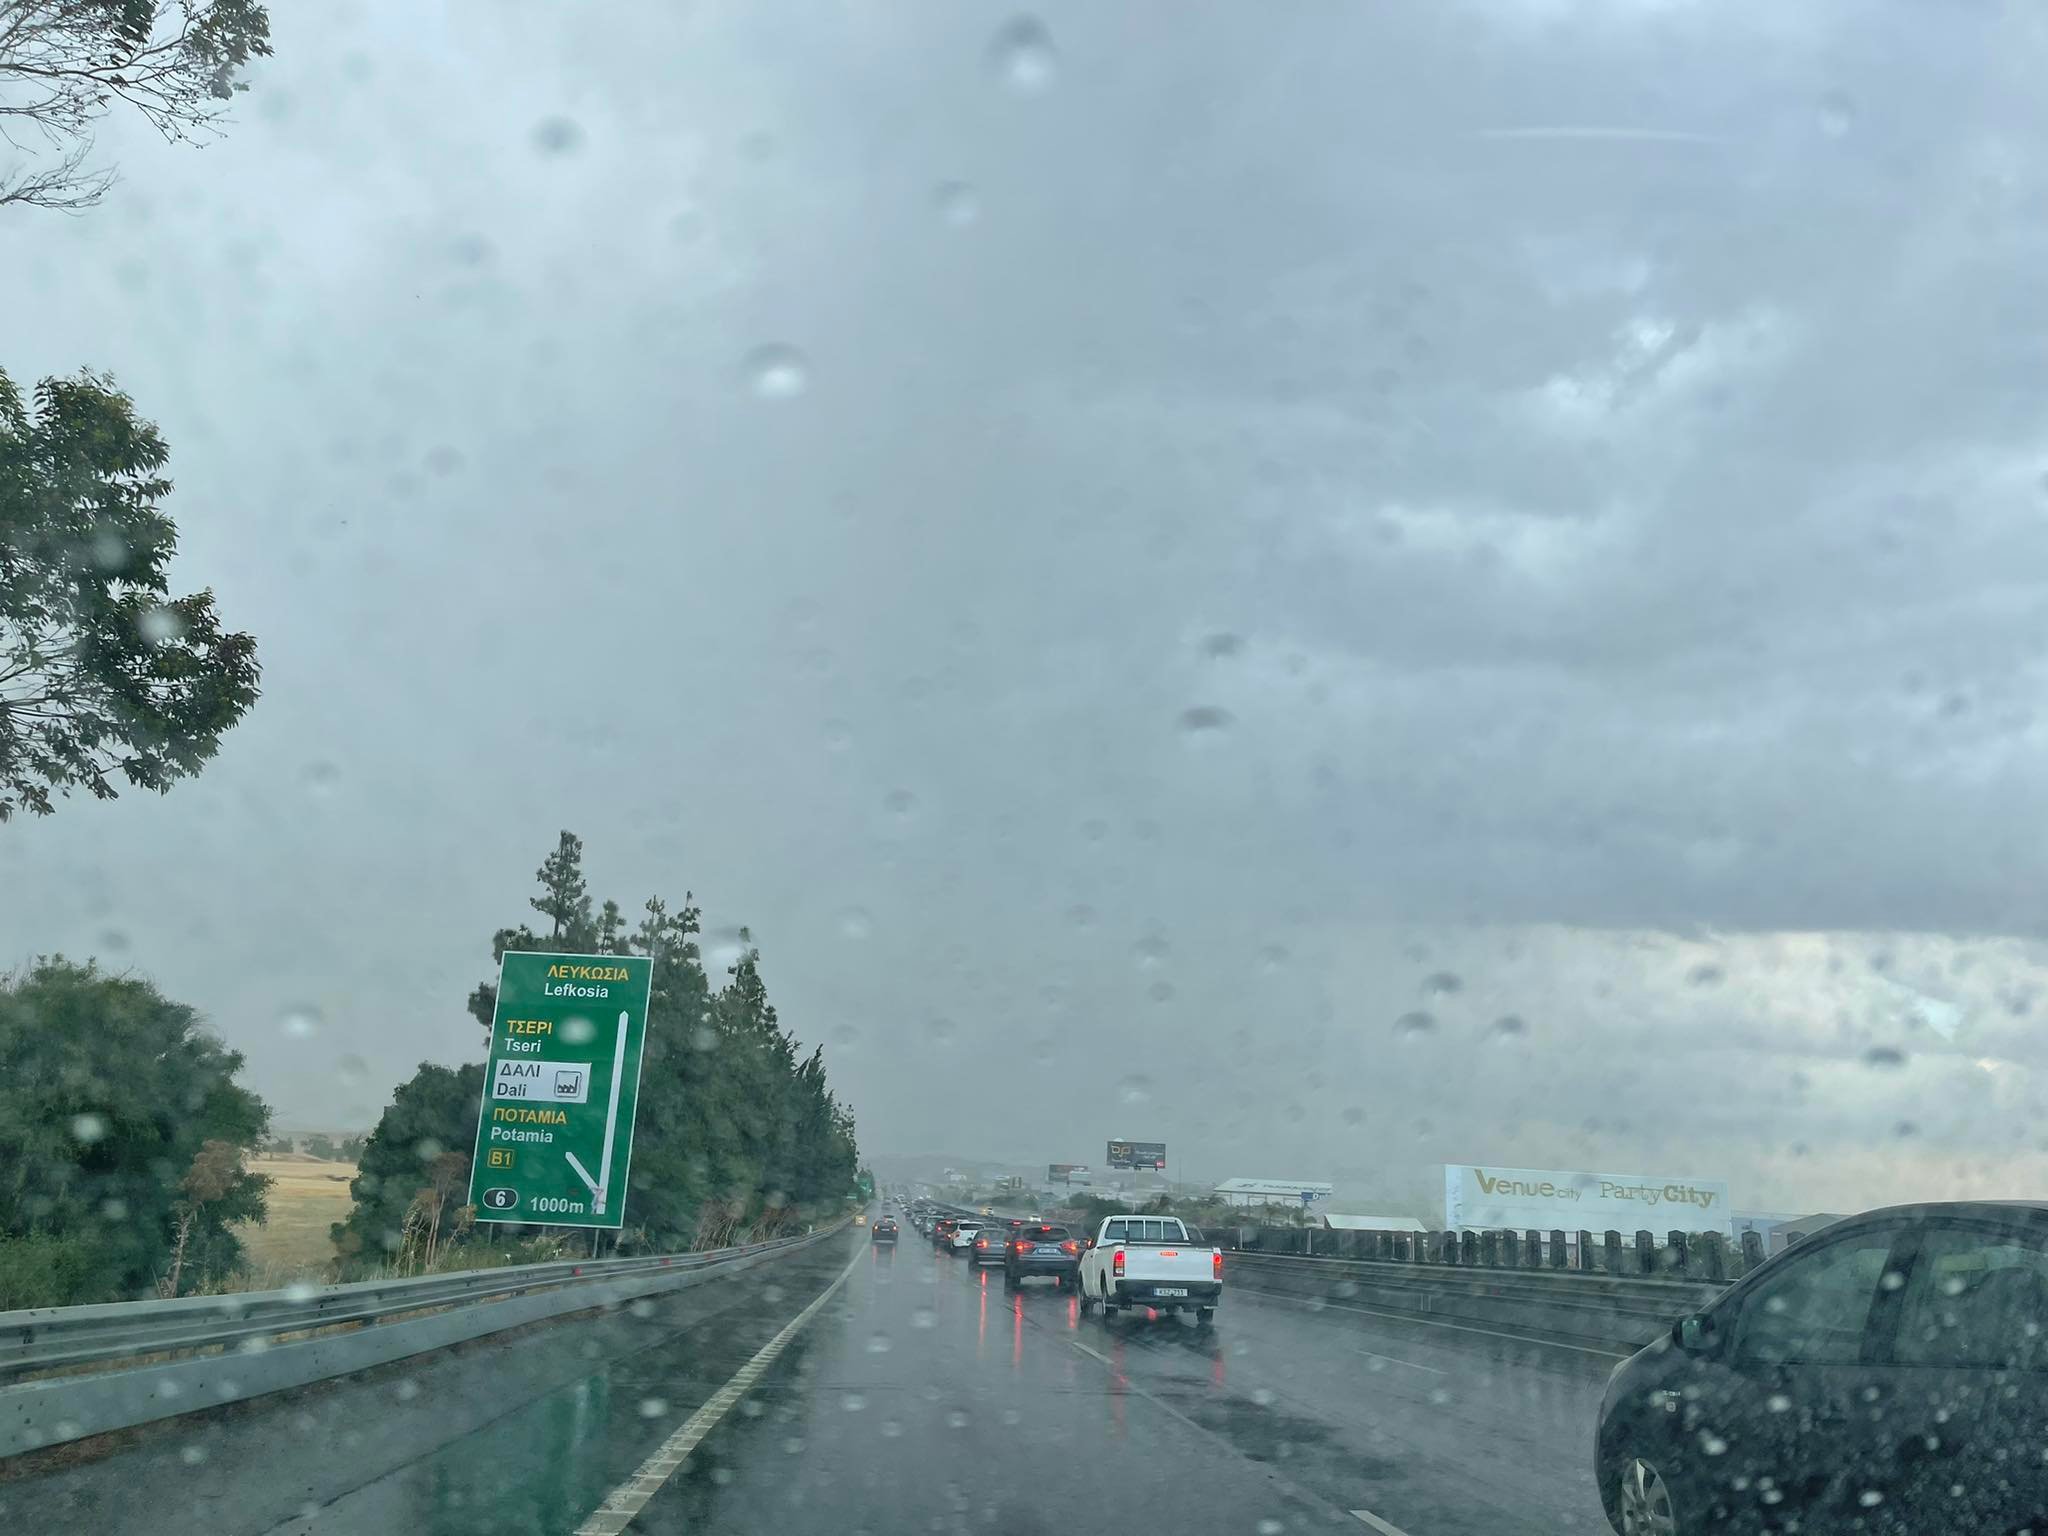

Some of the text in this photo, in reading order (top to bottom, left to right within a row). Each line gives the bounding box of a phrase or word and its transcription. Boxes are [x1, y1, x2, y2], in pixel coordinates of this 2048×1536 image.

[547, 964, 629, 981] ΛΕΥΚΩΣΙΑ
[544, 982, 609, 998] Lefkosia
[506, 1019, 552, 1035] ΤΣΕΡΙ
[504, 1037, 541, 1053] Tseri
[500, 1063, 541, 1078] ΔΑΛΙ
[497, 1082, 527, 1097] Dali
[492, 1107, 567, 1124] ΠΟΤΑΜΙΑ
[490, 1126, 554, 1143] Potamia
[490, 1151, 512, 1166] B1
[495, 1191, 506, 1207] 6
[530, 1196, 584, 1214] 1000m
